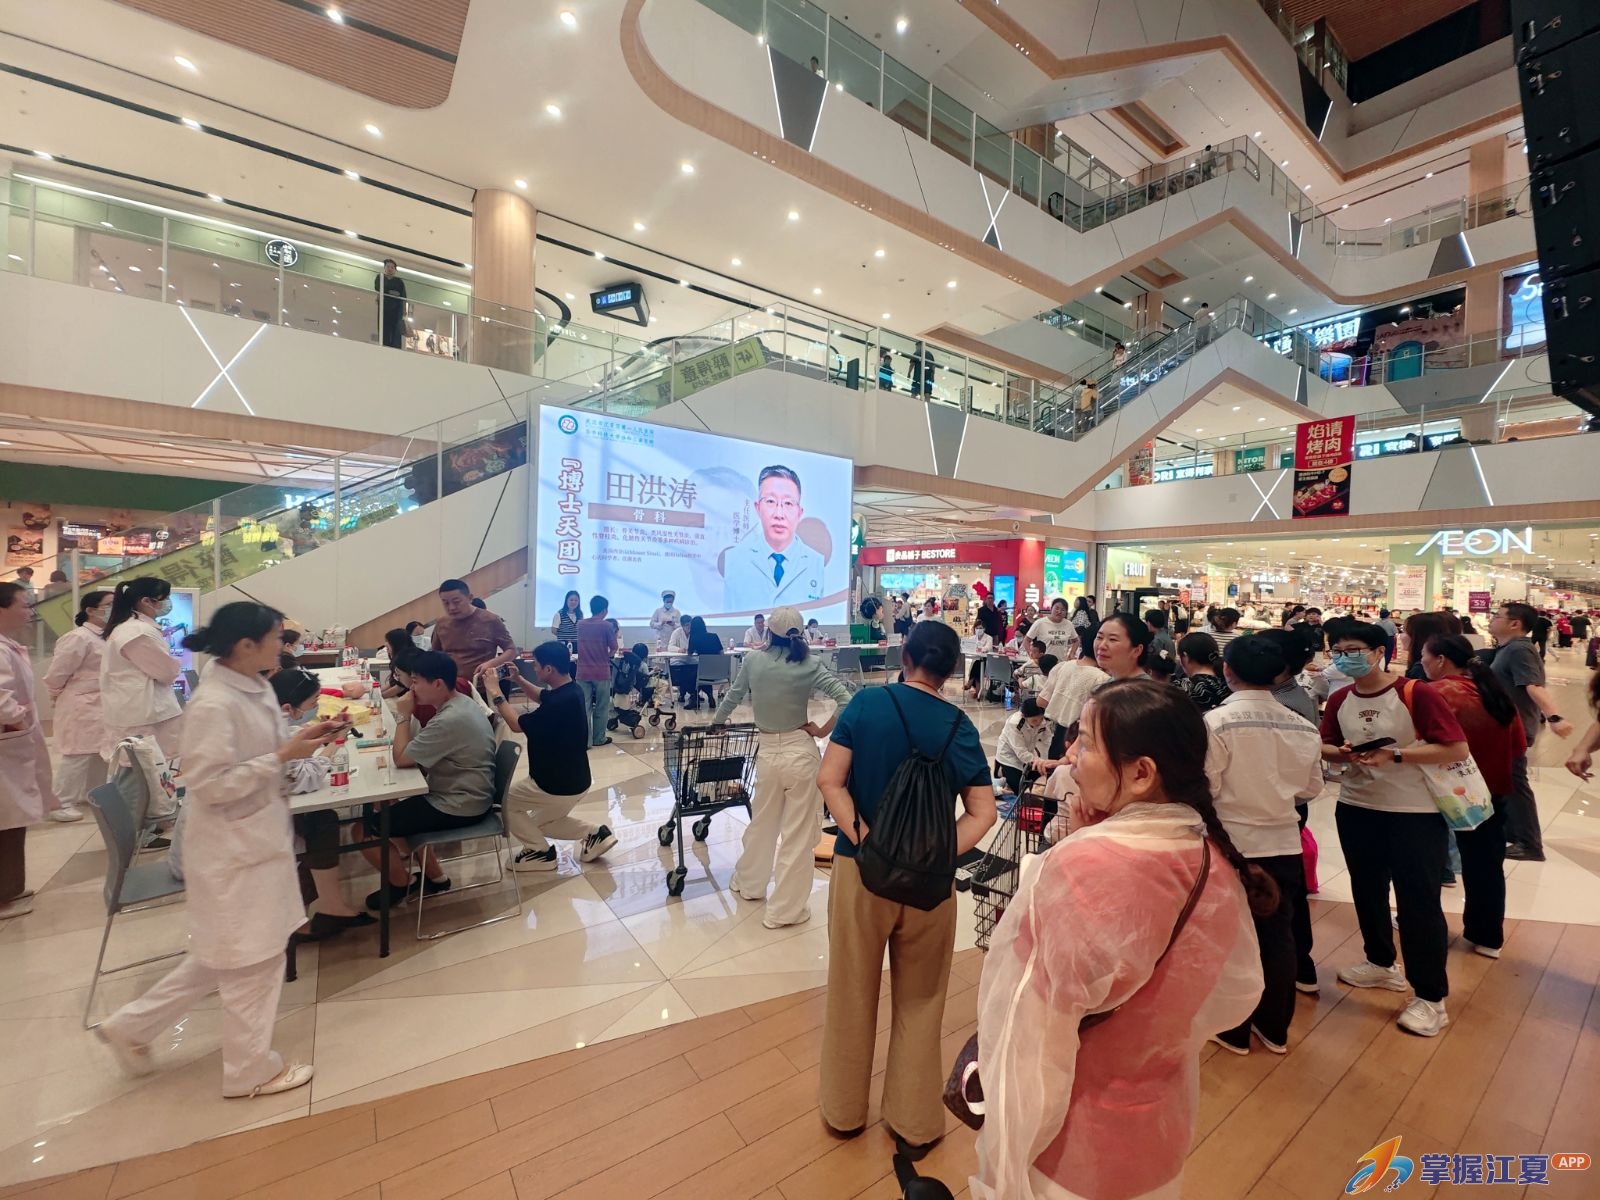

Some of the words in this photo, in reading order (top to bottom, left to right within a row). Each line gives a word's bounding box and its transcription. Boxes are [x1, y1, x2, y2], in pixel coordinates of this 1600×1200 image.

[1307, 420, 1343, 440] 焰请
[1305, 437, 1341, 456] 烤肉
[606, 471, 698, 509] 田洪涛
[732, 512, 740, 543] 医学博士
[895, 551, 920, 560] 良品铺子
[921, 549, 956, 559] BESTORE
[1124, 562, 1147, 577] FRUIT
[1358, 709, 1381, 719] SNOOPY
